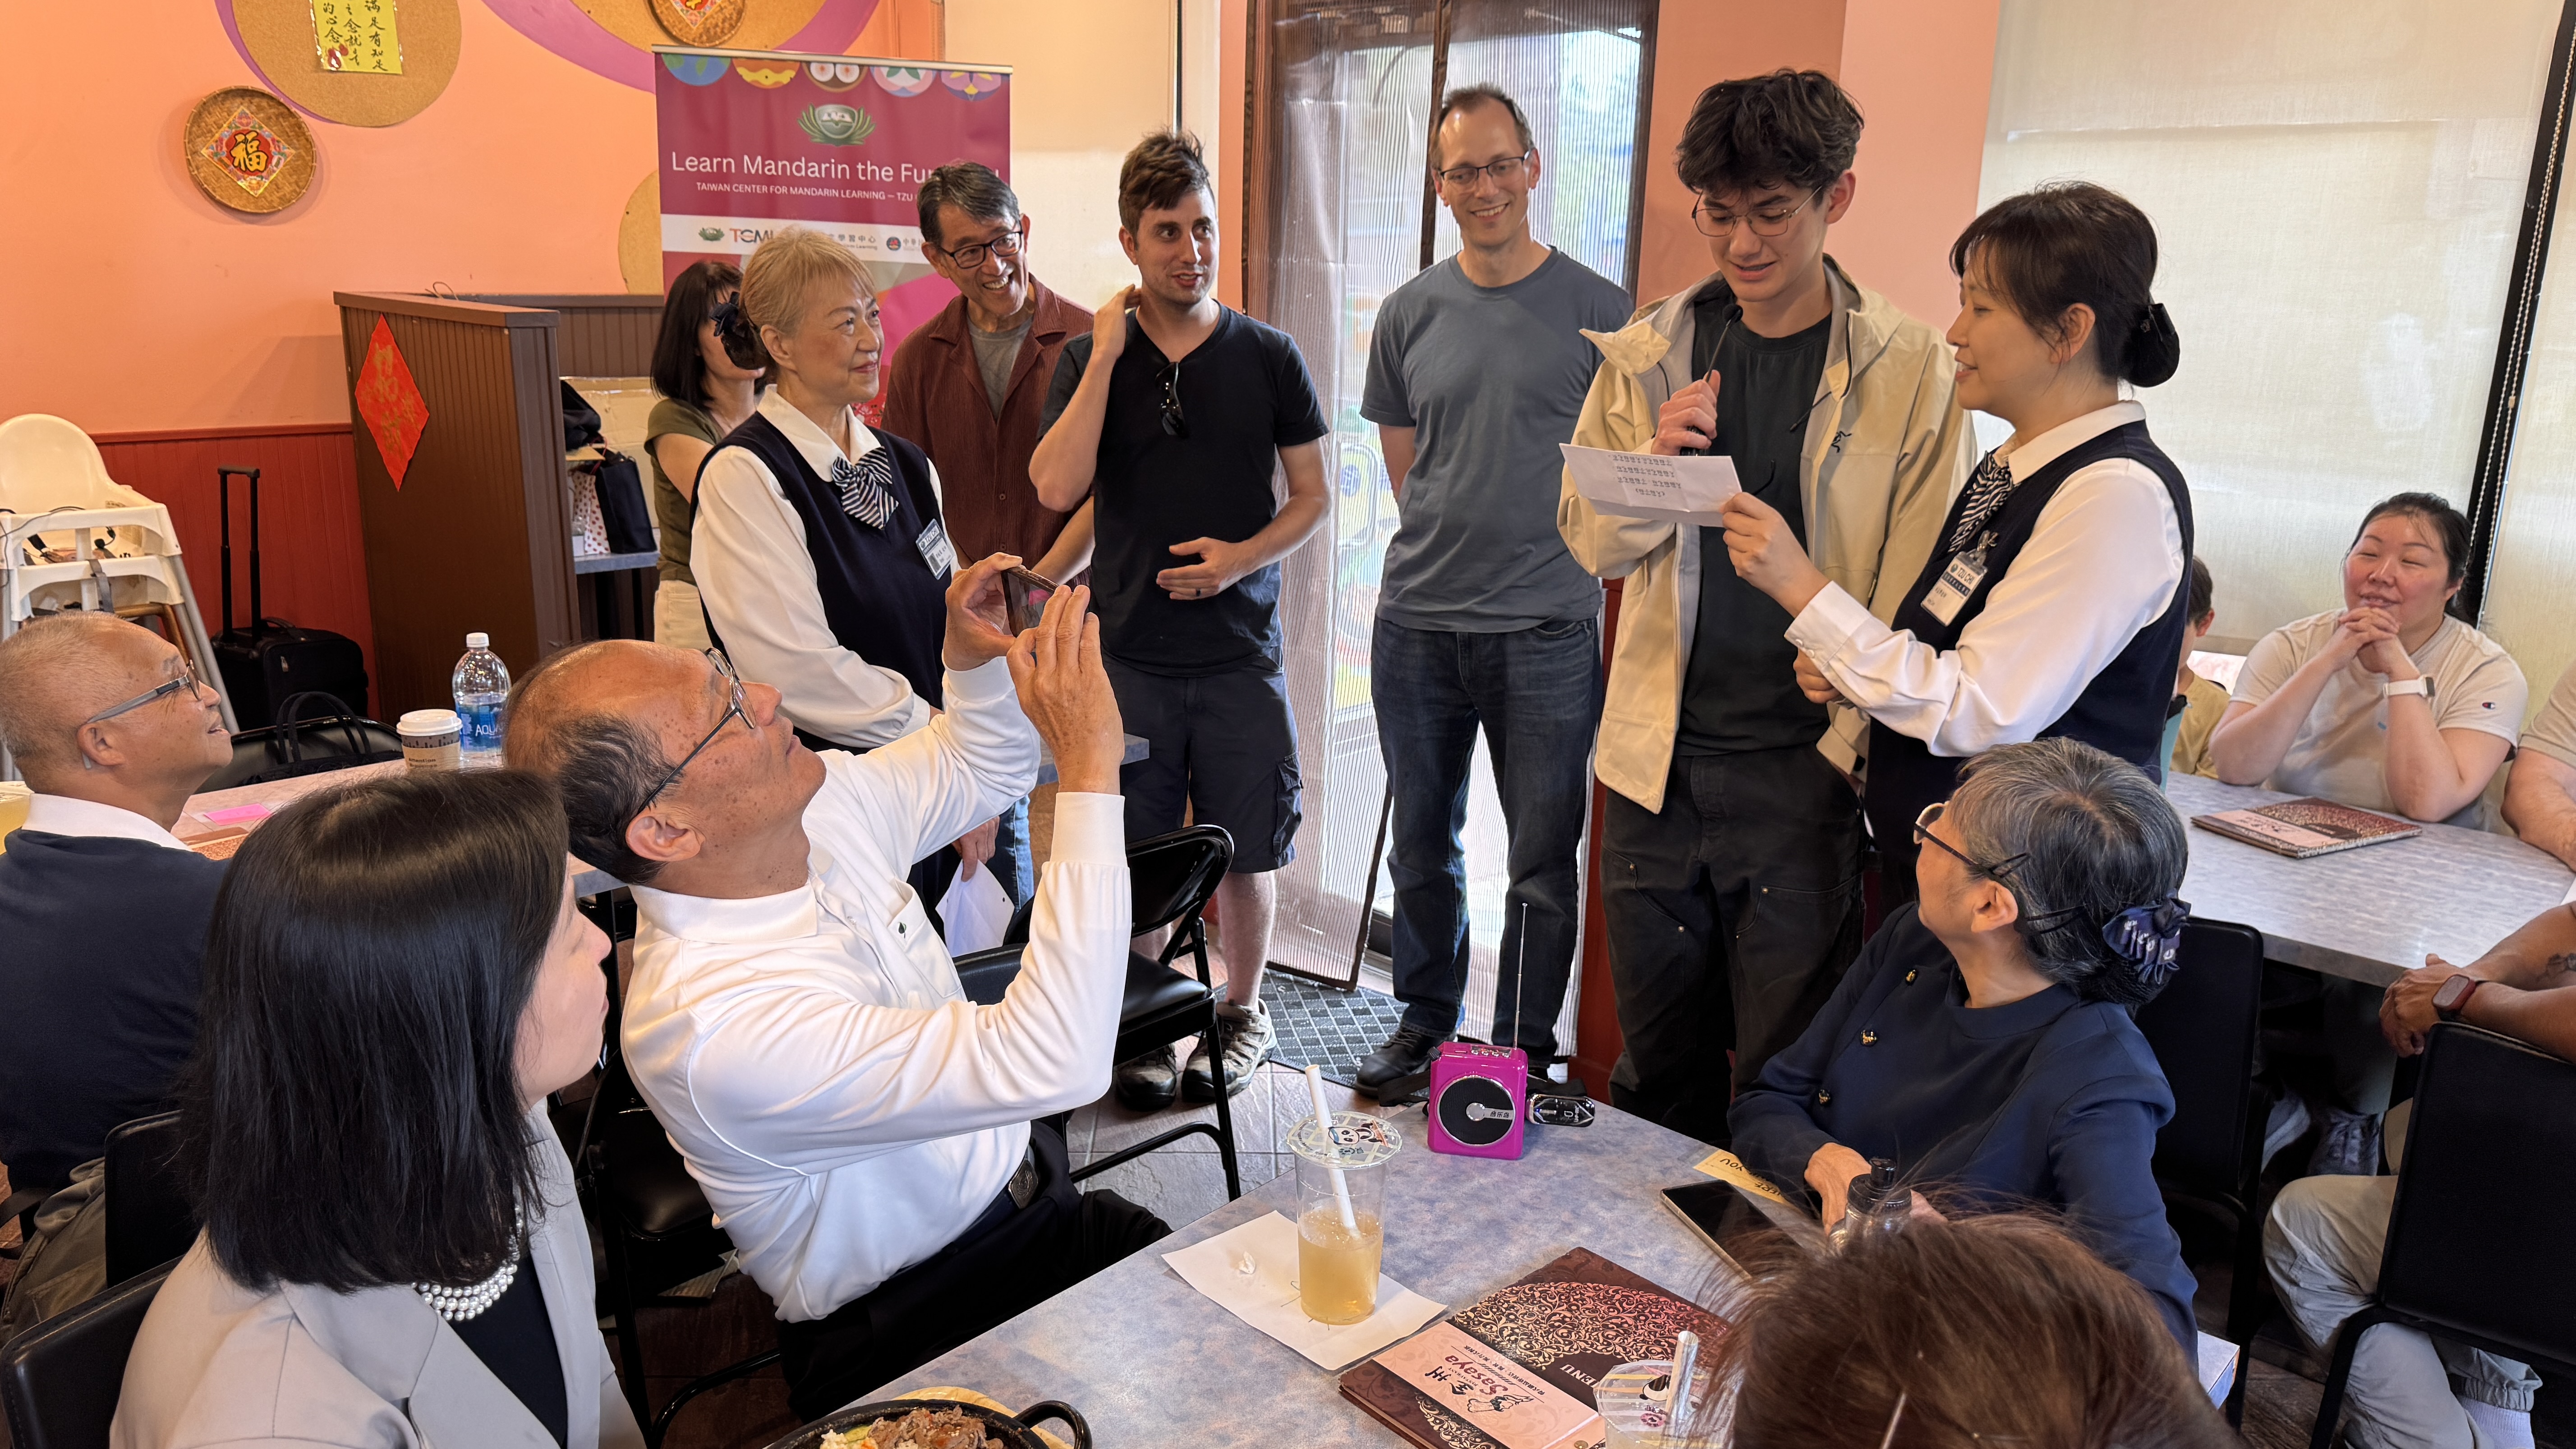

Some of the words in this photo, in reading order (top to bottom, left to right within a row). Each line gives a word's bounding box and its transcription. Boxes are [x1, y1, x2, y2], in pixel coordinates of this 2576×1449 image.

[230, 130, 269, 172] 福
[672, 152, 735, 173] Learn
[744, 154, 850, 179] Mandarin
[856, 160, 893, 182] the
[697, 182, 730, 192] TAIWAN
[732, 184, 768, 194] CENTER
[770, 185, 788, 195] FOR
[790, 187, 838, 198] MANDARIN
[841, 189, 885, 200] LEARNING
[897, 192, 913, 202] TZU
[1720, 1158, 1746, 1172] YOU
[1444, 1355, 1509, 1395] Sasaya
[1448, 1367, 1478, 1387] RESTAURANT
